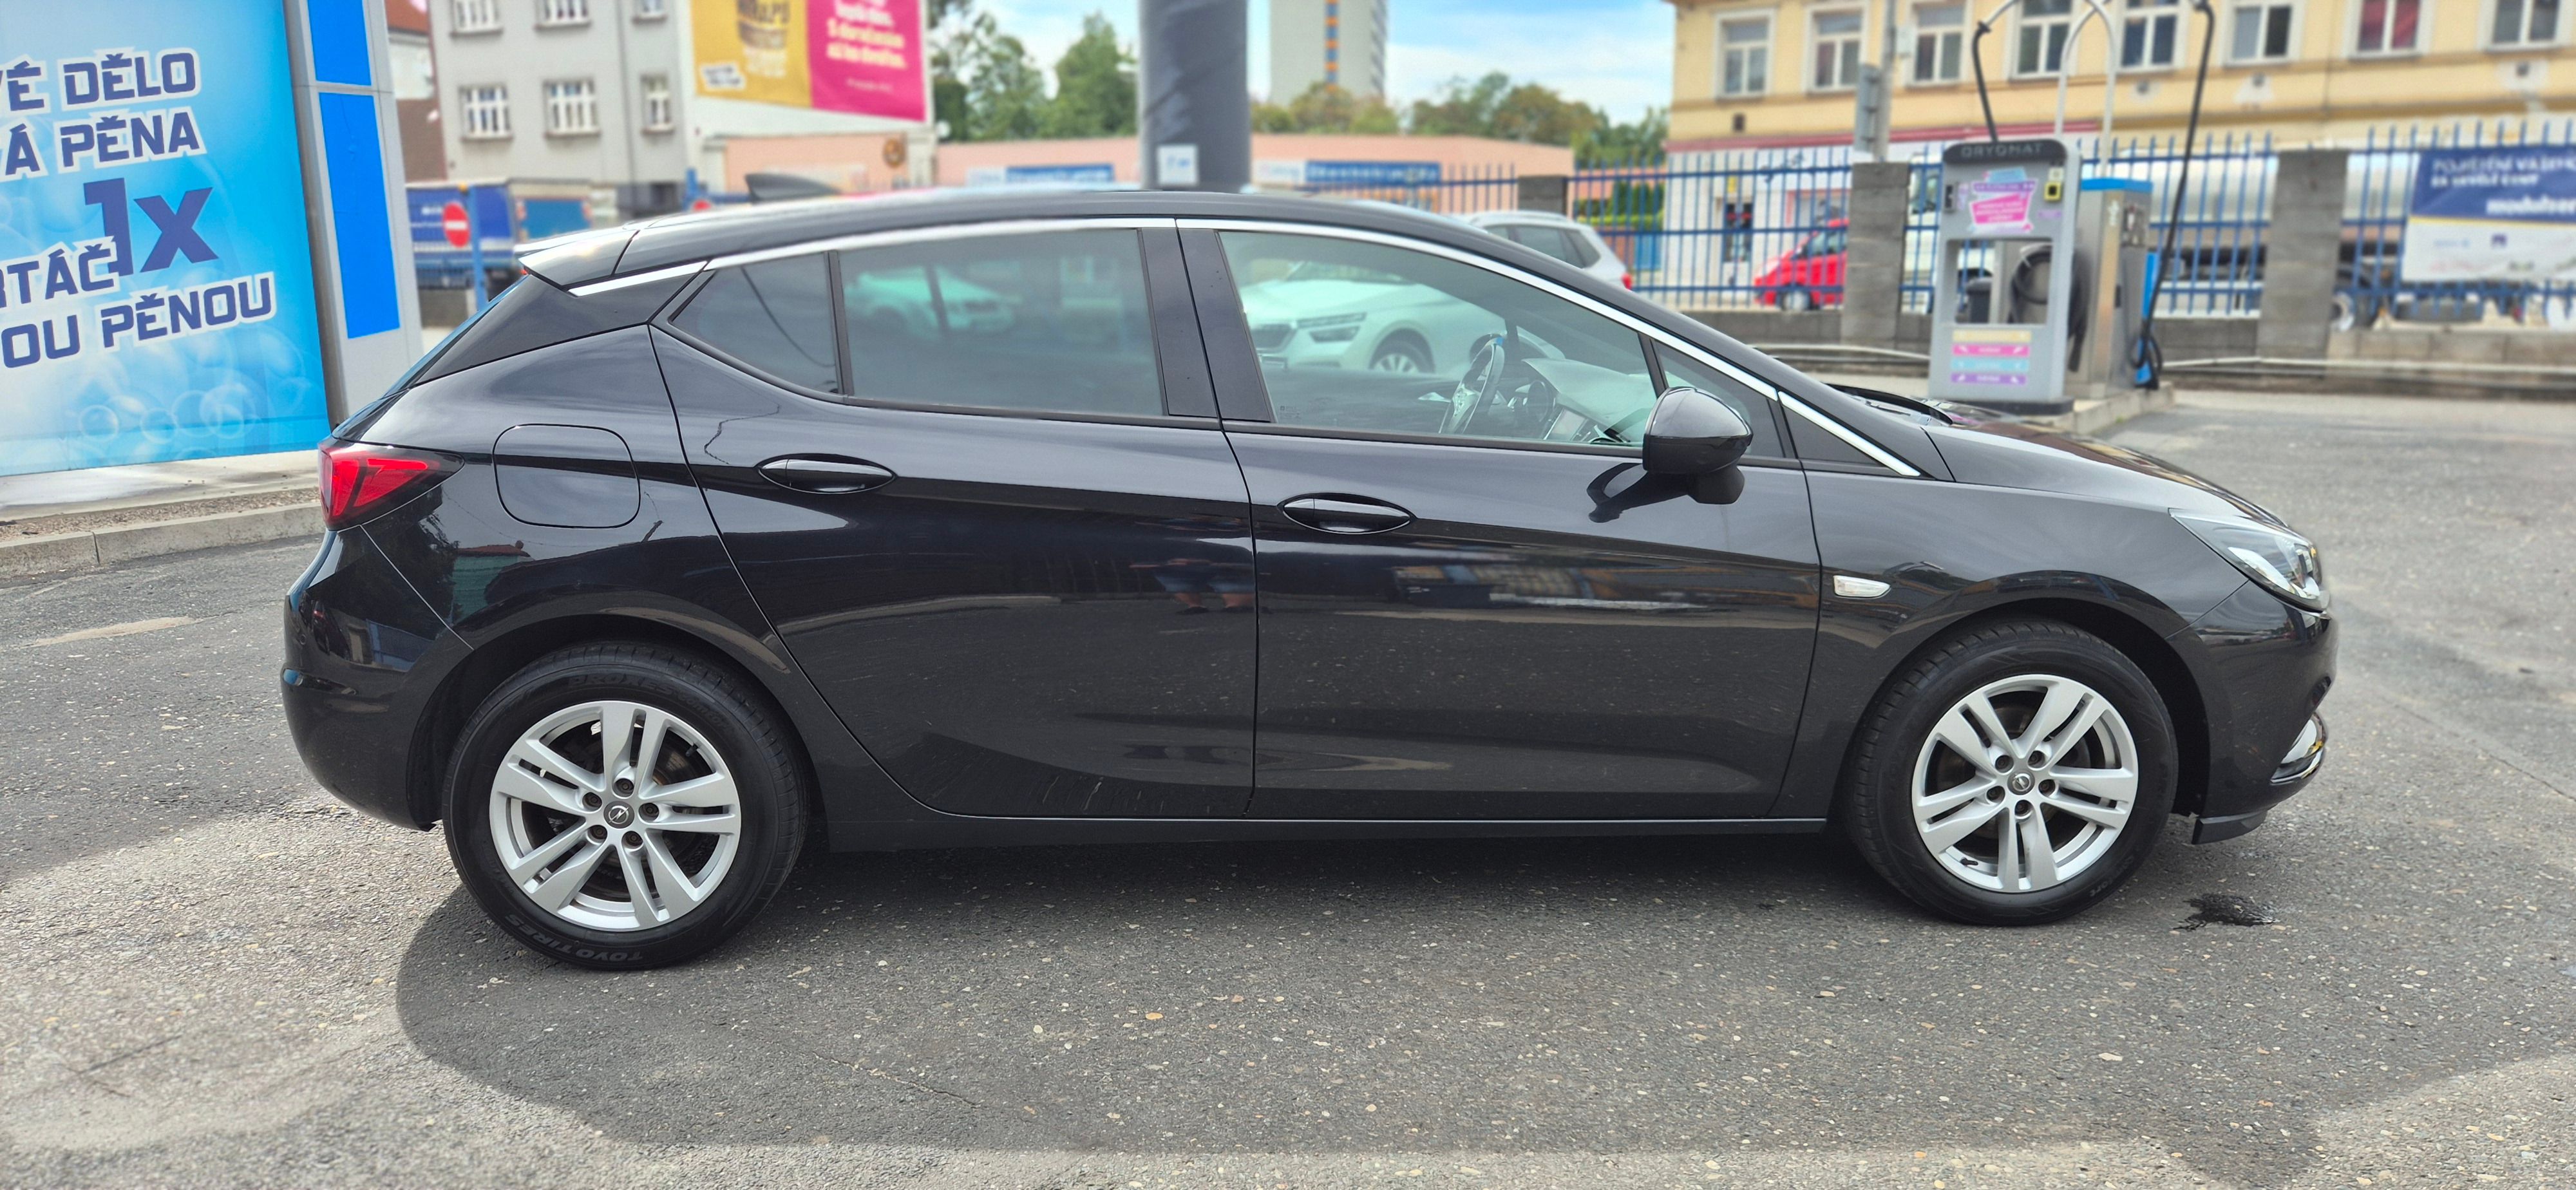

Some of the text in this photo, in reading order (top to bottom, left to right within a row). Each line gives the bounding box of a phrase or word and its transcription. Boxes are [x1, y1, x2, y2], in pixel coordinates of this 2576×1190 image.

[0, 52, 196, 111] É DĚLO
[60, 112, 200, 167] PĚNA
[84, 178, 219, 277] 1x
[0, 243, 115, 308] TÁČ
[1, 277, 272, 368] OU PĚNOU
[505, 914, 643, 961] TOYO TIRES
